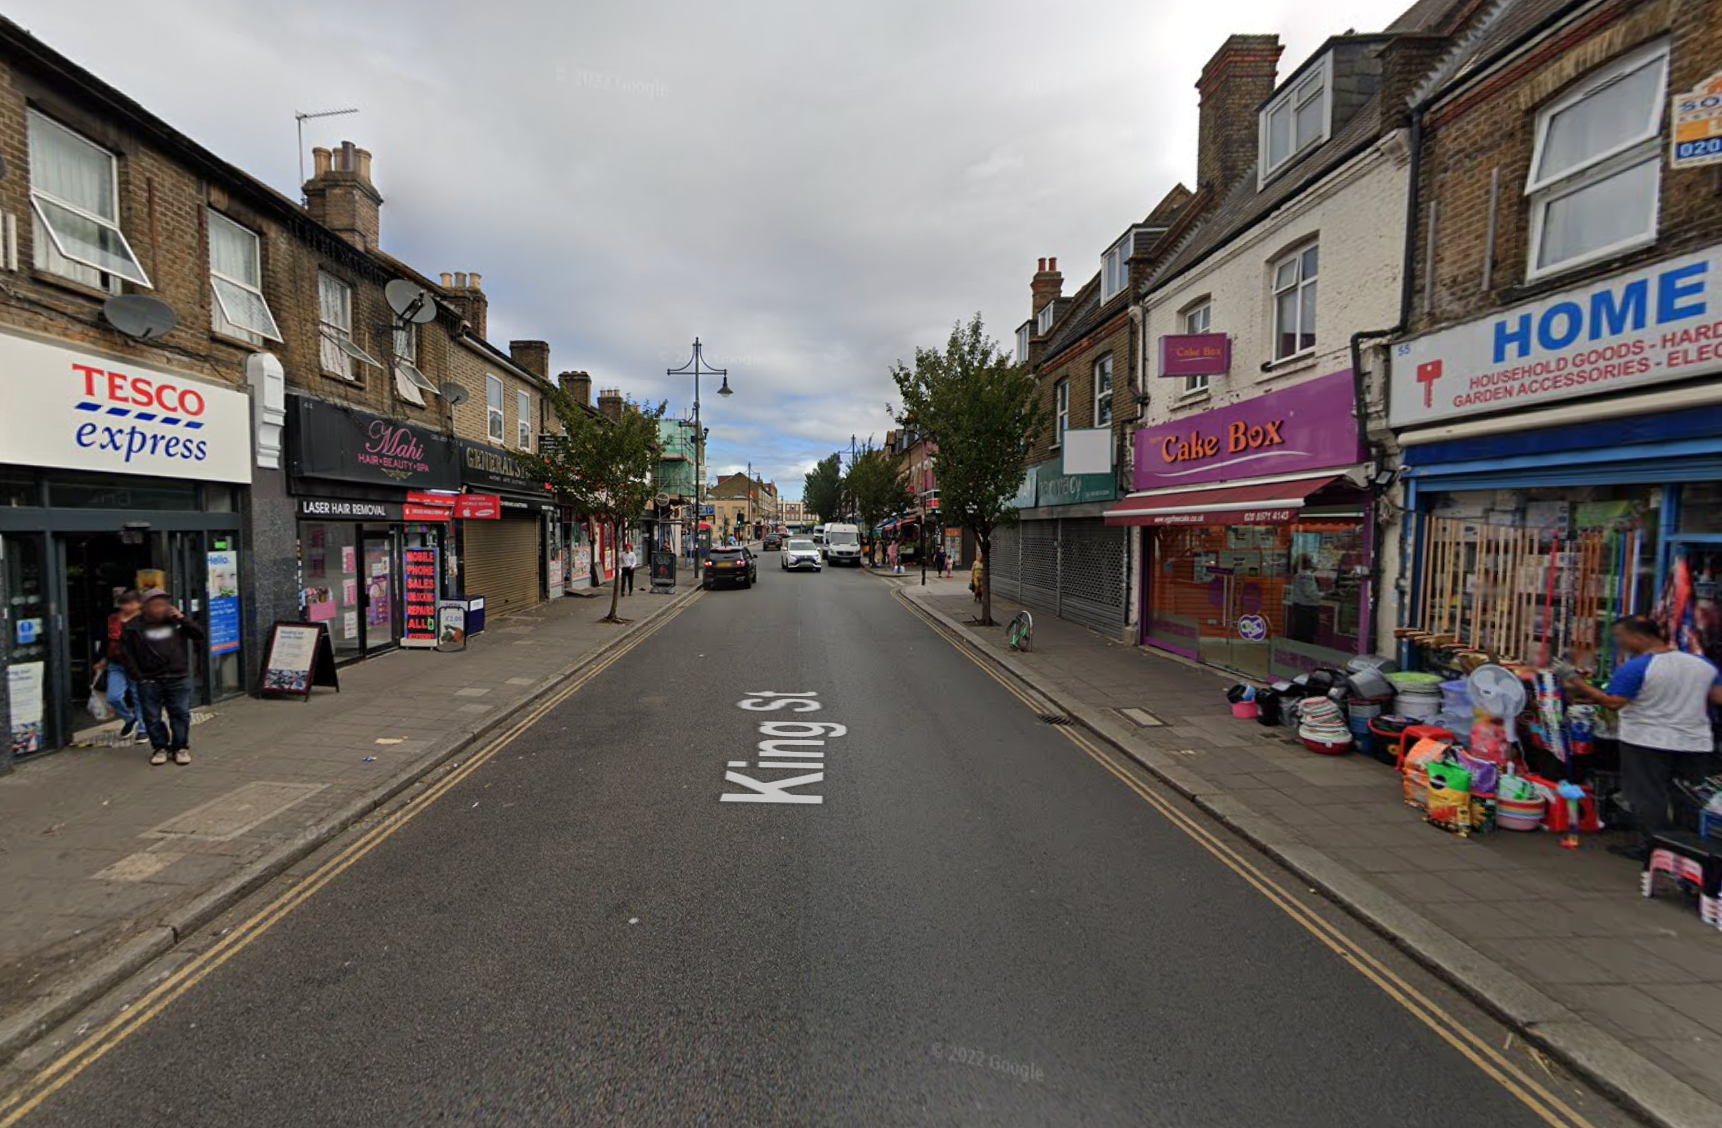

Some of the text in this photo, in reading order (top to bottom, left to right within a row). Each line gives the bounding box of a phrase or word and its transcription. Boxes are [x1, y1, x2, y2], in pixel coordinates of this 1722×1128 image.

[1680, 137, 1720, 158] 020
[1493, 261, 1710, 364] HOME
[1176, 346, 1223, 357] Cake Box
[1470, 356, 1568, 390] HOUSEHOLD
[1572, 340, 1645, 368] GOODS
[72, 363, 205, 417] TESCO
[1453, 386, 1513, 407] GARDEN
[1516, 356, 1650, 397] ACCESSORIES
[76, 421, 207, 462] express
[365, 420, 424, 460] Mahi
[1161, 419, 1285, 463] Cake Box
[357, 453, 430, 473] HAIR BEAUTY SPA
[466, 447, 514, 476] GENERAL
[303, 501, 386, 516] LASER HAIR REMOVAL
[1244, 512, 1255, 521] 020
[406, 551, 434, 562] MOBILE
[406, 565, 434, 576] PHONE
[407, 578, 434, 589] SALES
[408, 619, 427, 629] ALL
[719, 691, 847, 804] King St
